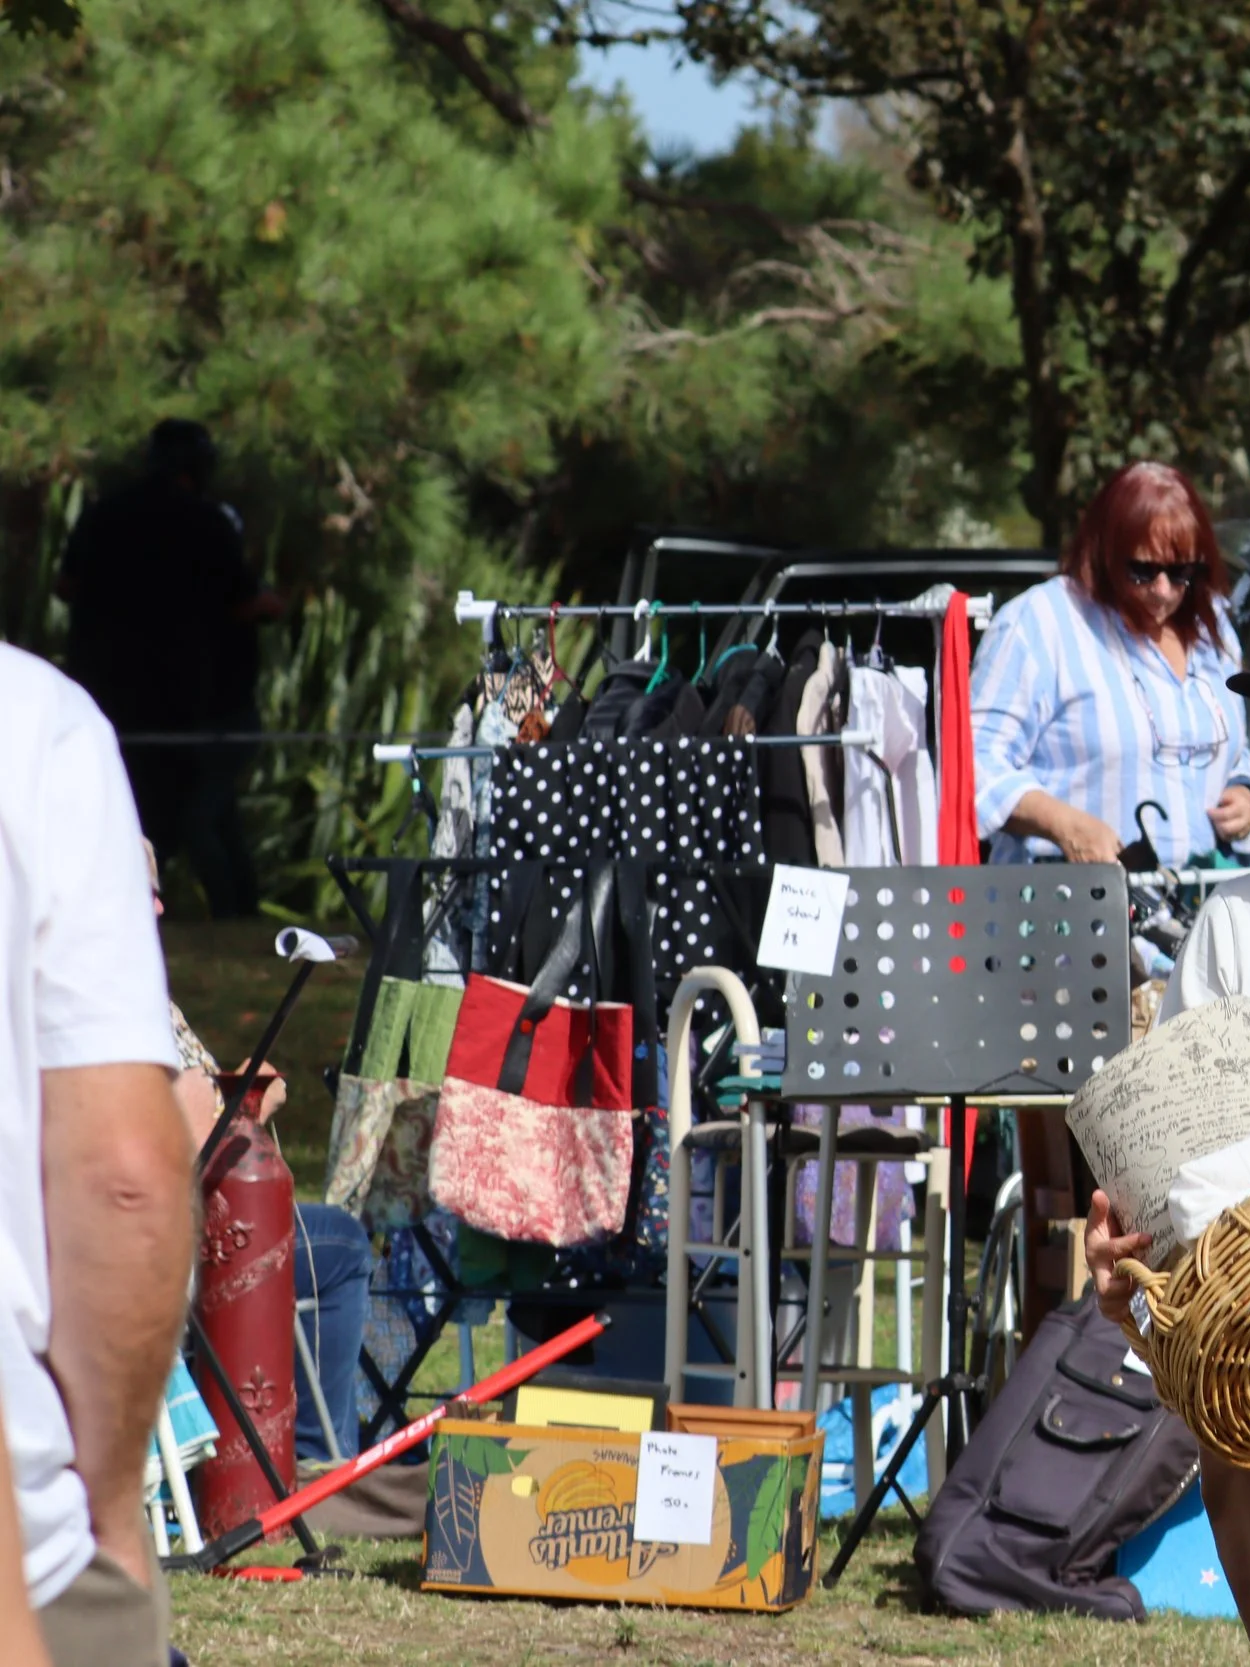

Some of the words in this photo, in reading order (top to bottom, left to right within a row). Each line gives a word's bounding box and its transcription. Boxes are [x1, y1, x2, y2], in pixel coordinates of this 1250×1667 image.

[352, 1393, 468, 1475] SPOR
[592, 1448, 639, 1467] ANANAS
[529, 1528, 679, 1580] Atlantis
